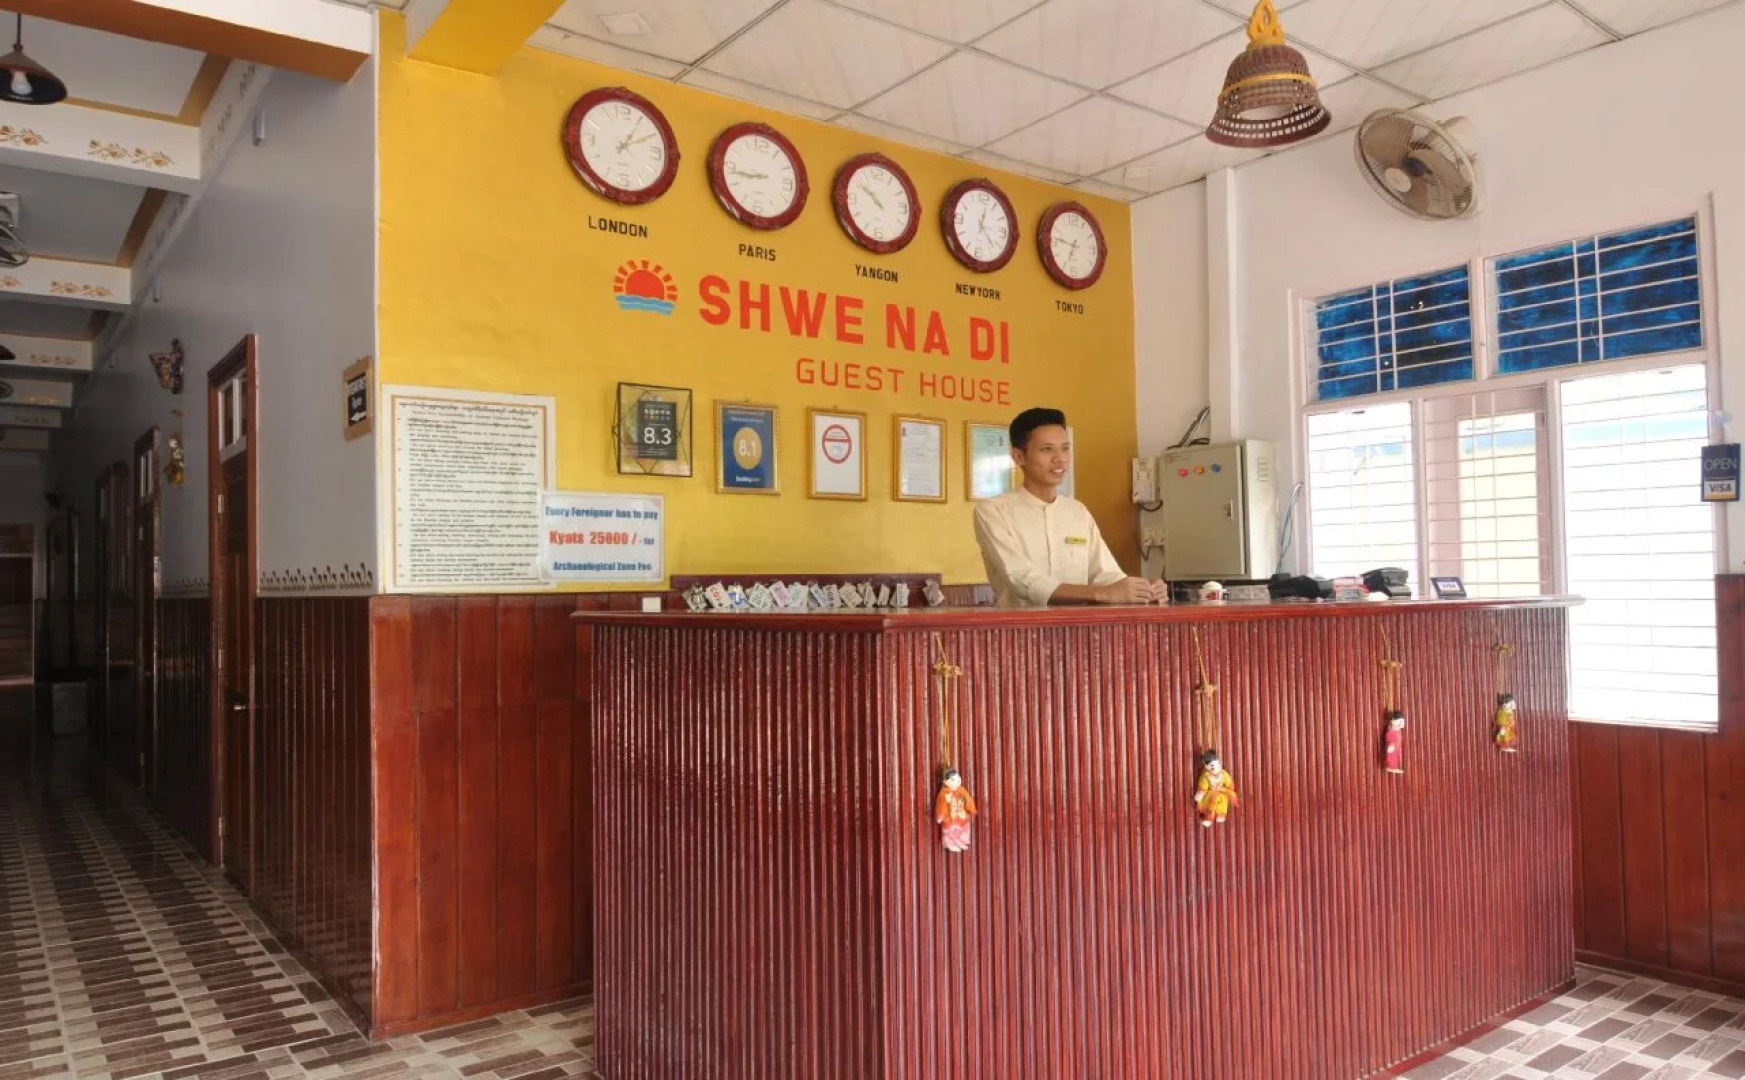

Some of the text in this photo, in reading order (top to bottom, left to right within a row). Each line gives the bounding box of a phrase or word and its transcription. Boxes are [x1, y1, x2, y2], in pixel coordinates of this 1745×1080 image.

[614, 105, 631, 121] 12
[649, 145, 661, 162] 3
[754, 138, 769, 154] 12
[896, 202, 908, 215] 3
[589, 216, 648, 238] LONDON
[739, 244, 776, 262] PARIS
[855, 265, 898, 283] YANGON
[1055, 299, 1084, 316] TOKYO
[698, 275, 1012, 365] SHWE NA DI
[796, 358, 1011, 406] GUEST HOUSE
[644, 427, 672, 446] 8.3
[738, 438, 757, 458] 8.1
[1704, 457, 1737, 471] OPEN
[1708, 483, 1732, 493] VISA
[544, 505, 659, 520] Every Foreigner has to pay
[549, 530, 585, 546] Kyats
[589, 531, 629, 546] 25000
[553, 561, 653, 572] Archaeological Zone Fee
